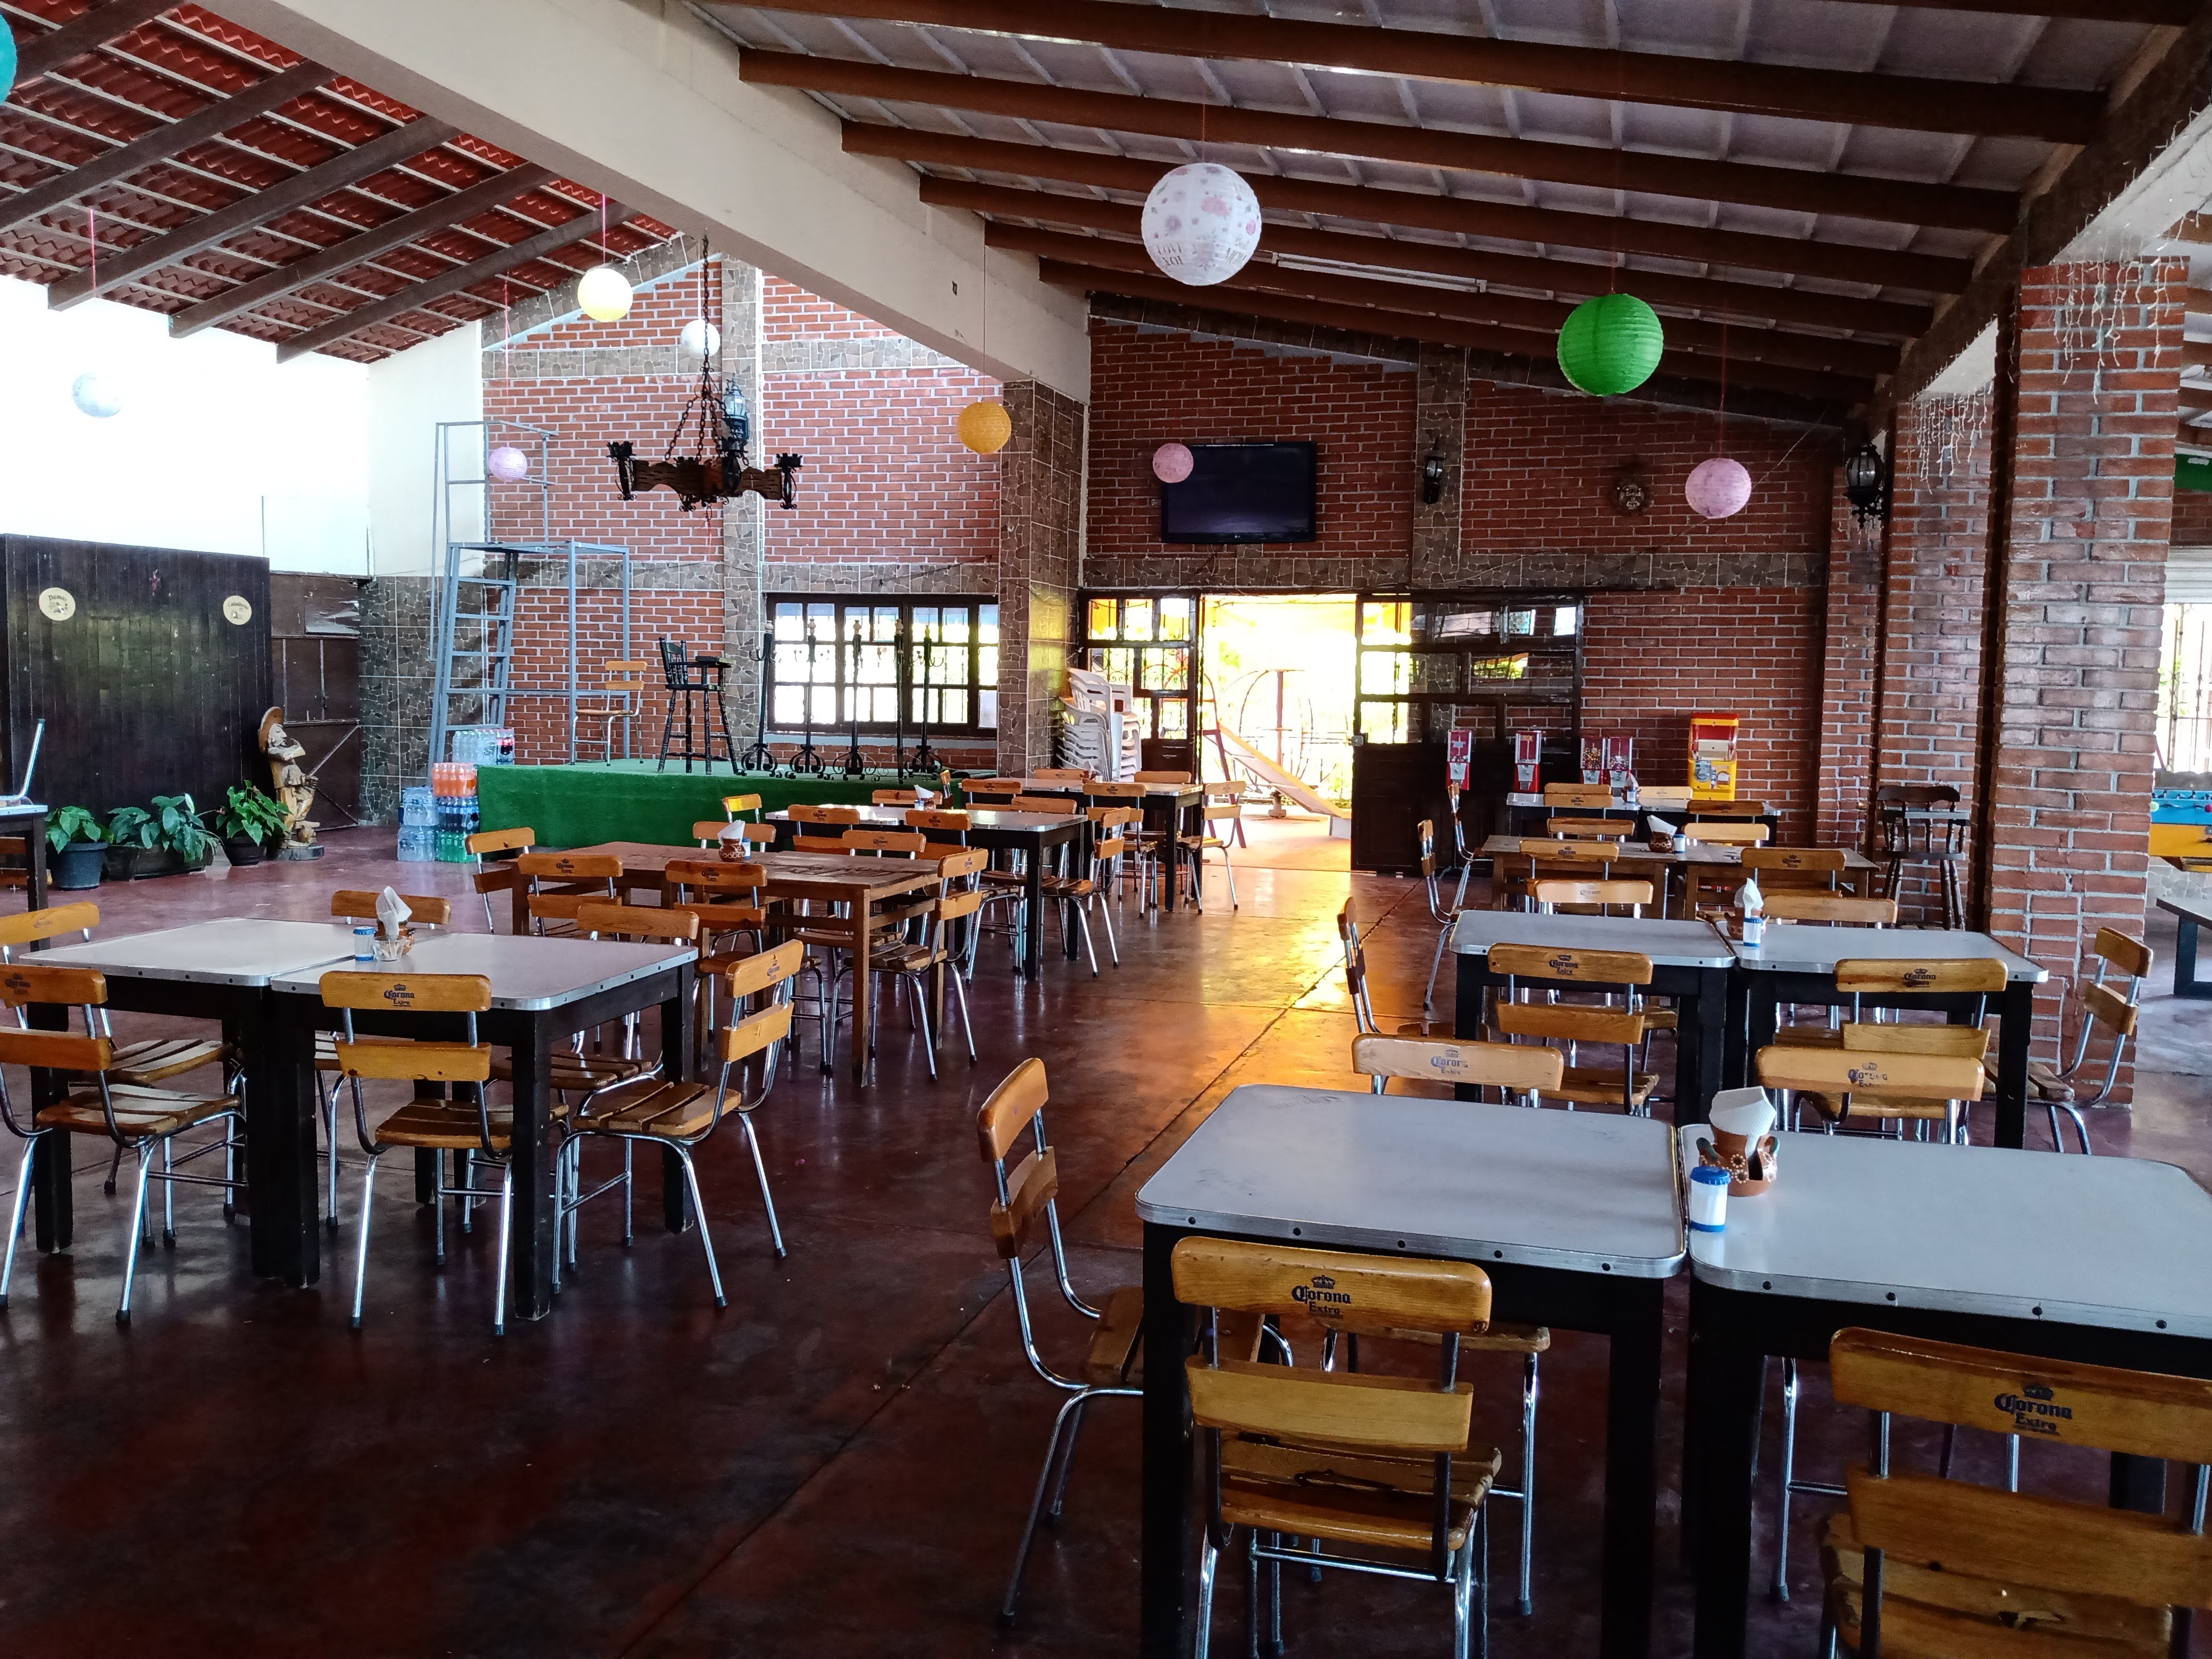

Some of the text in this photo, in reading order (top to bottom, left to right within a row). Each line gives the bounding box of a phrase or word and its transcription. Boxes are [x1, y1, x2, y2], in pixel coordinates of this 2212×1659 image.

[384, 990, 415, 1000] Corona
[1292, 1285, 1351, 1304] Corona
[1309, 1301, 1340, 1313] Extra
[1994, 1393, 2072, 1419] Corona
